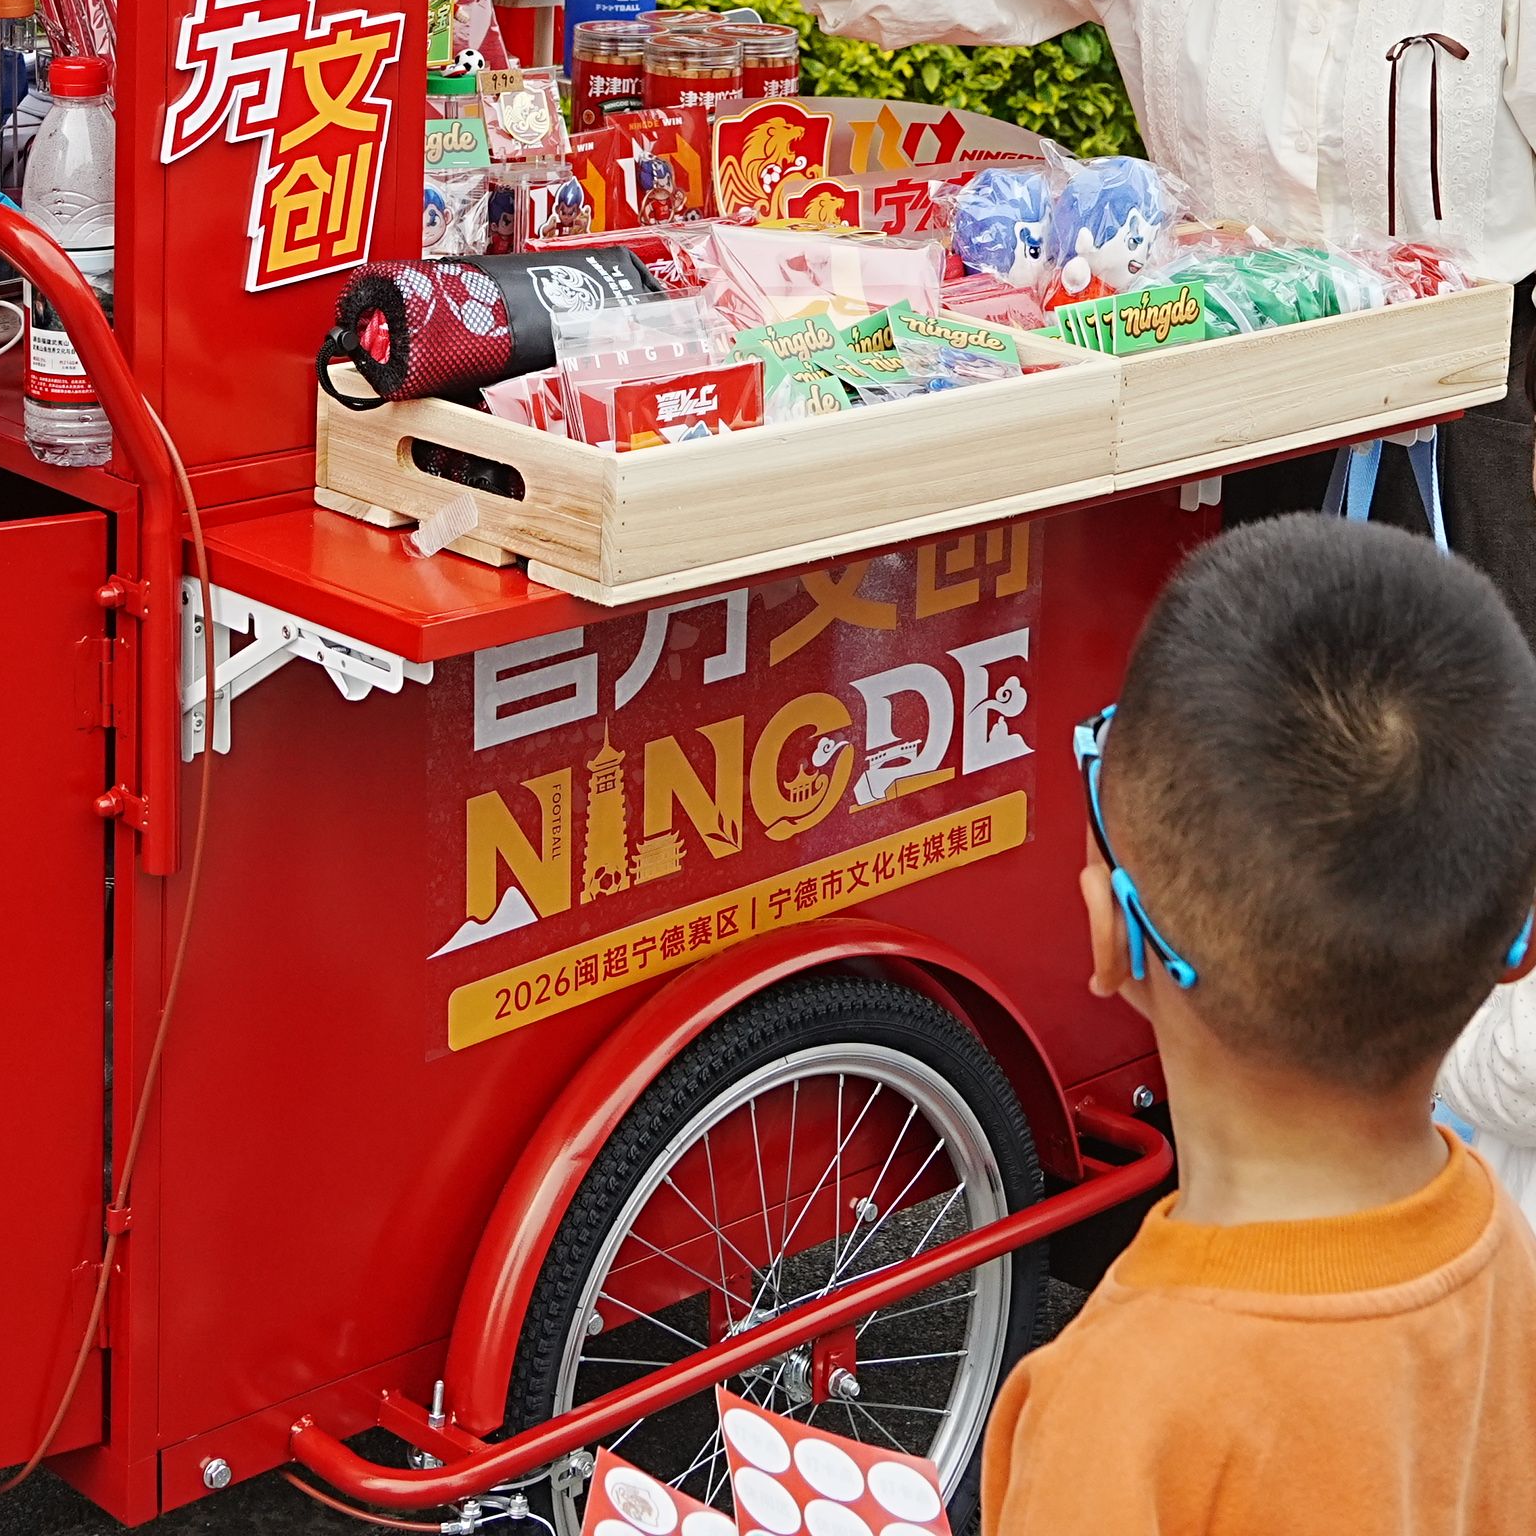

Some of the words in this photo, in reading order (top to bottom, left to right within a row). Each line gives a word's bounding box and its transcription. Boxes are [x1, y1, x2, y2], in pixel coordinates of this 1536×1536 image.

[491, 73, 515, 91] 9.90
[662, 117, 683, 127] WIN
[267, 30, 392, 273] 文创
[425, 121, 478, 164] gde
[576, 142, 595, 153] WIN
[898, 314, 1007, 352] ningde
[1120, 286, 1201, 343] ningde
[551, 783, 563, 862] FOOTBALL
